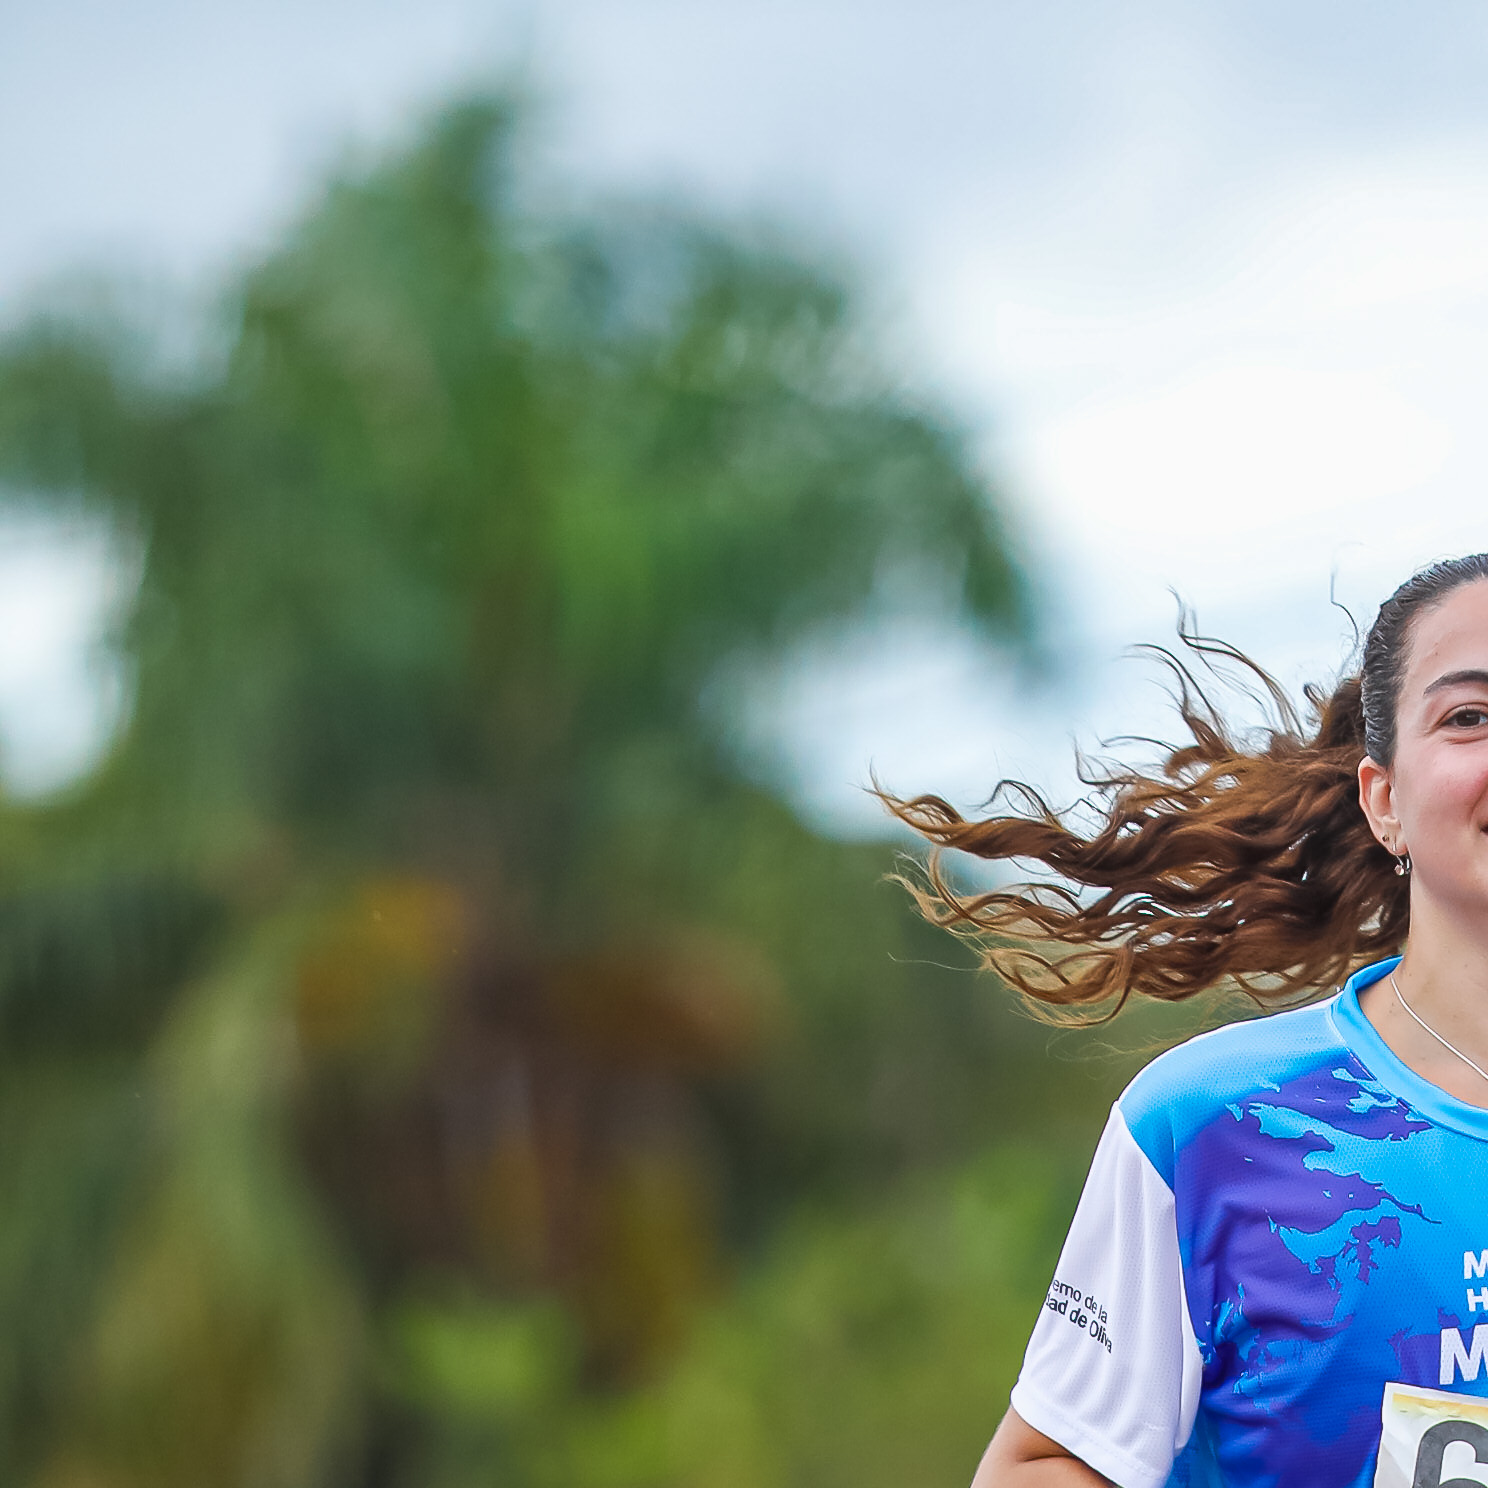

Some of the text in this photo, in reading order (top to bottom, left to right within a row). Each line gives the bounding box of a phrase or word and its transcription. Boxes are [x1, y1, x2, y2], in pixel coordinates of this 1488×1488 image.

[1084, 1295, 1098, 1315] de
[1097, 1304, 1108, 1324] la
[1069, 1307, 1087, 1328] de
[1089, 1319, 1112, 1353] Oliva
